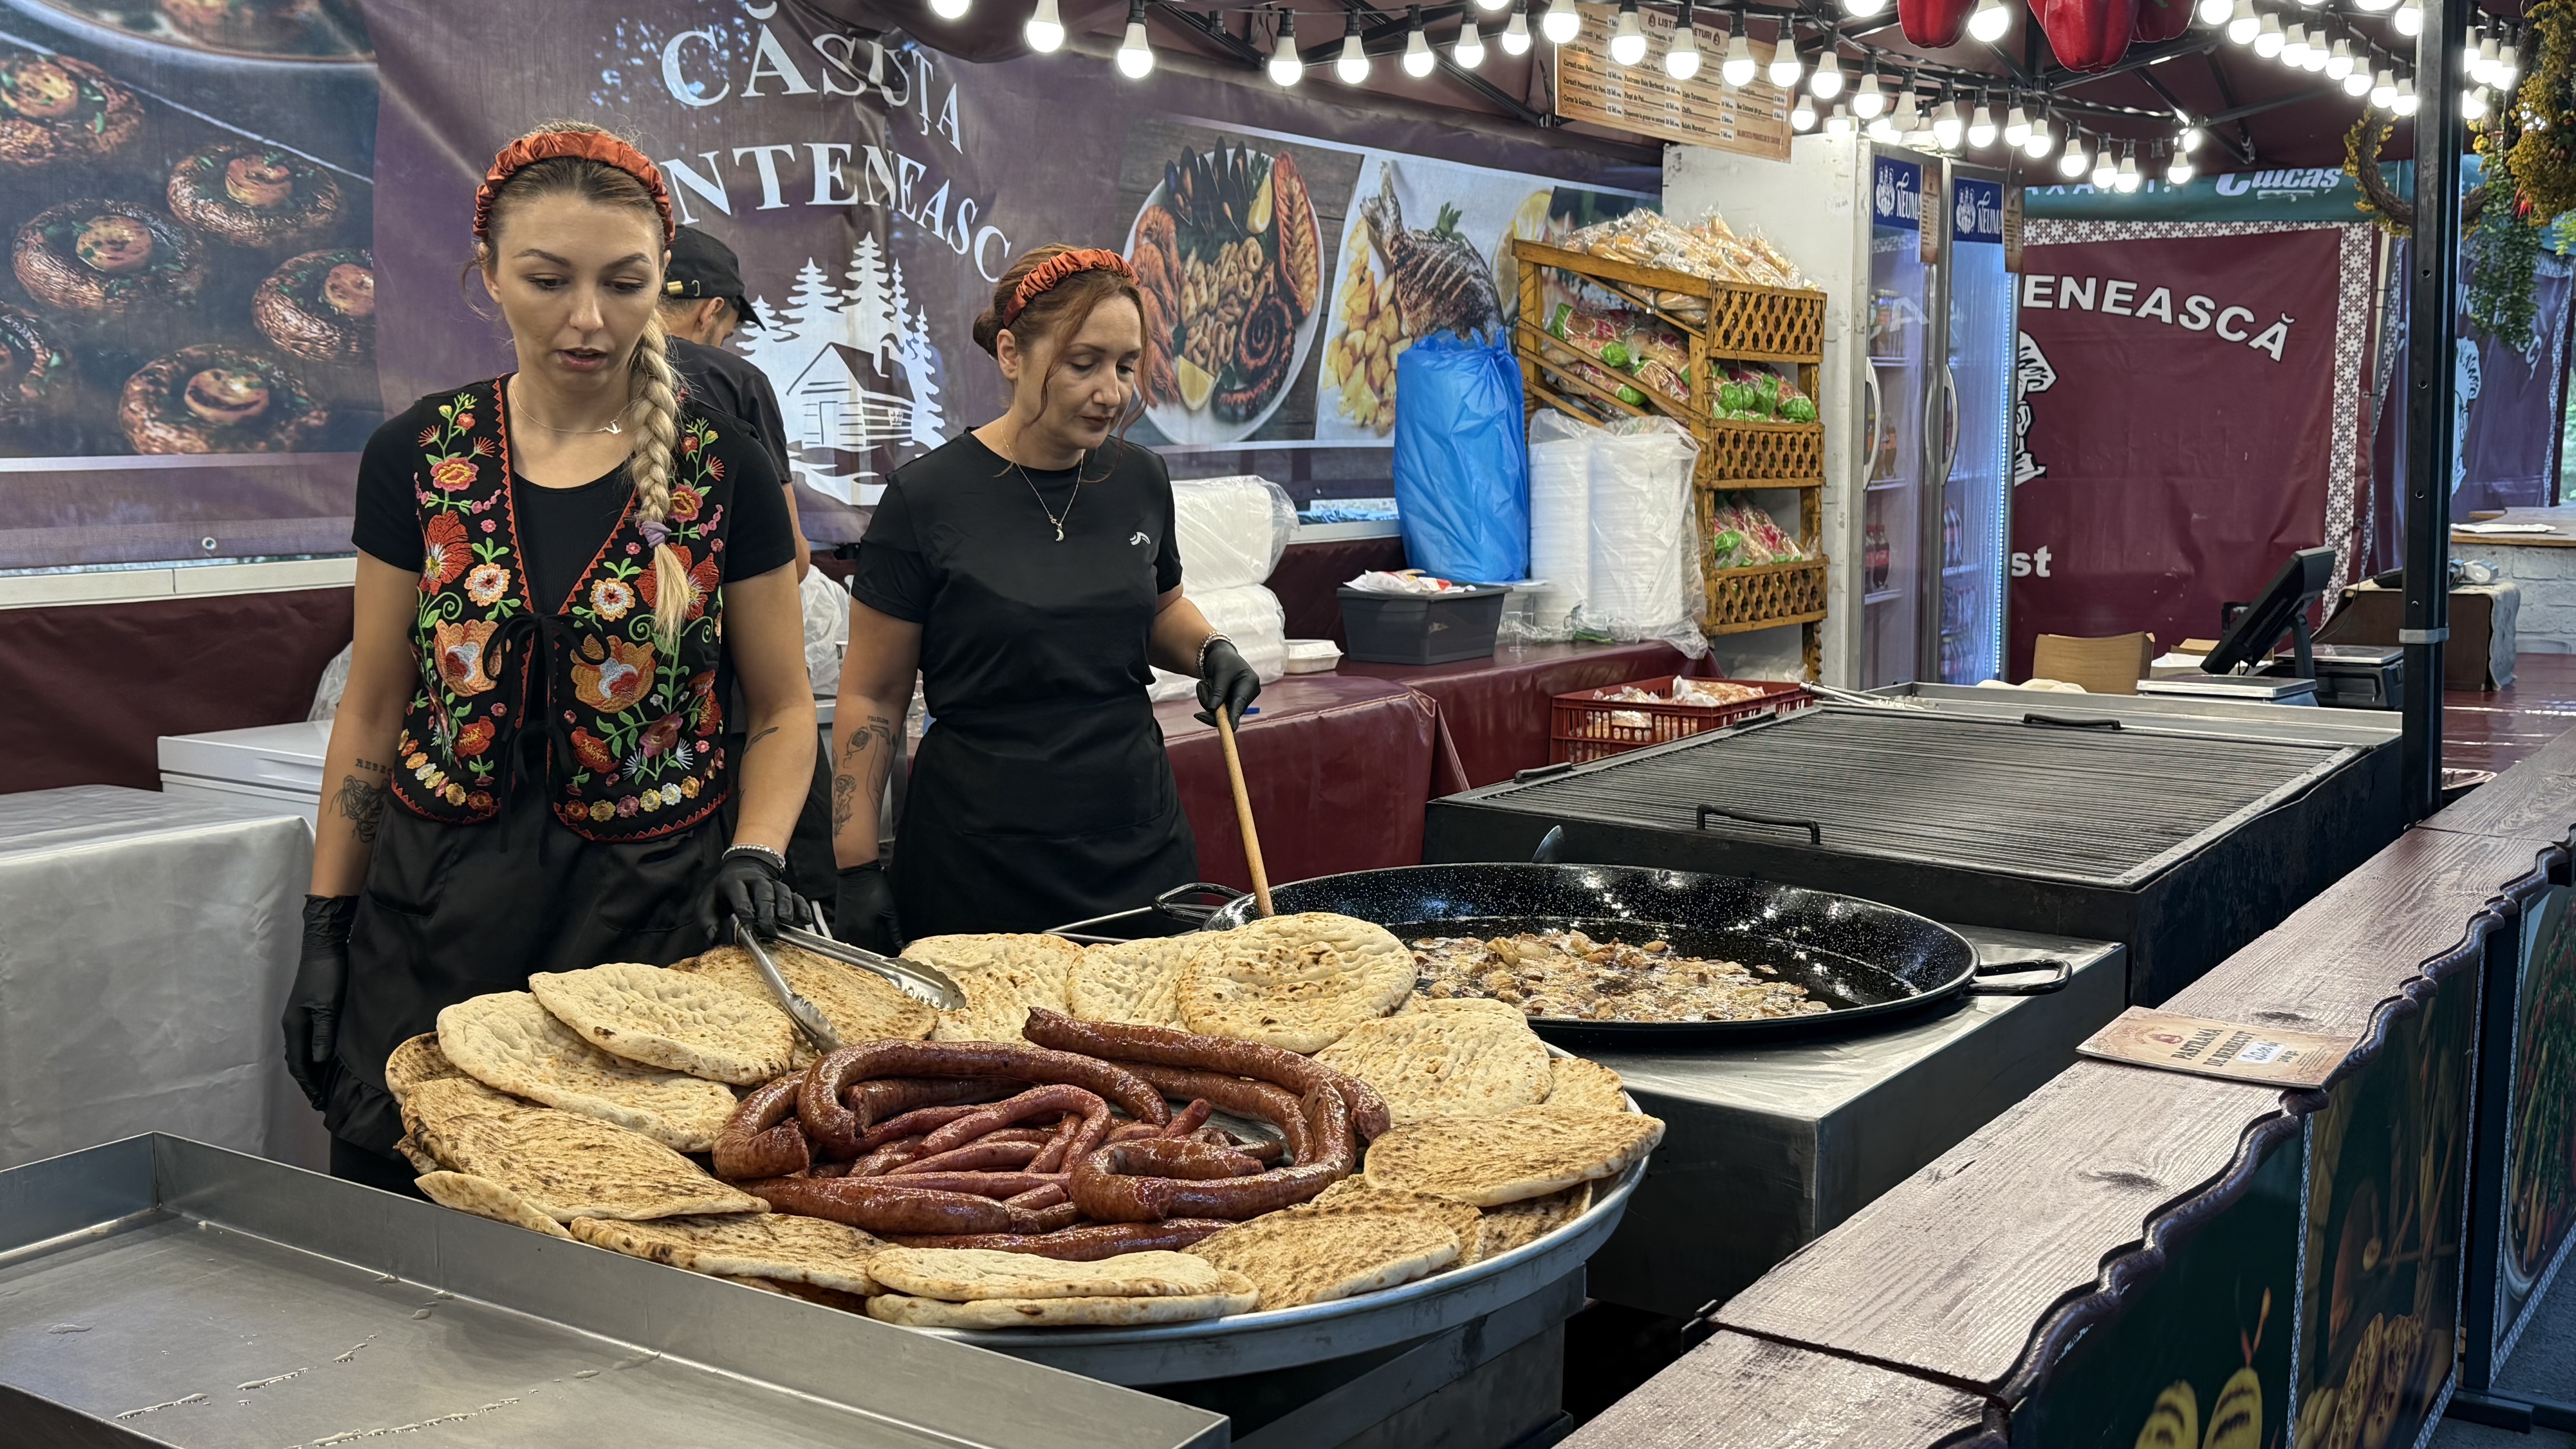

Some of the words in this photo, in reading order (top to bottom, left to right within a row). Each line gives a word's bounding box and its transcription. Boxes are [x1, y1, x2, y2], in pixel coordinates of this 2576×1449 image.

[662, 1, 962, 153] CĂSUȚA
[659, 143, 1011, 283] NTENEASC
[2023, 274, 2297, 363] ENEASCĂ
[2012, 545, 2052, 577] st
[2203, 1058, 2228, 1067] DE
